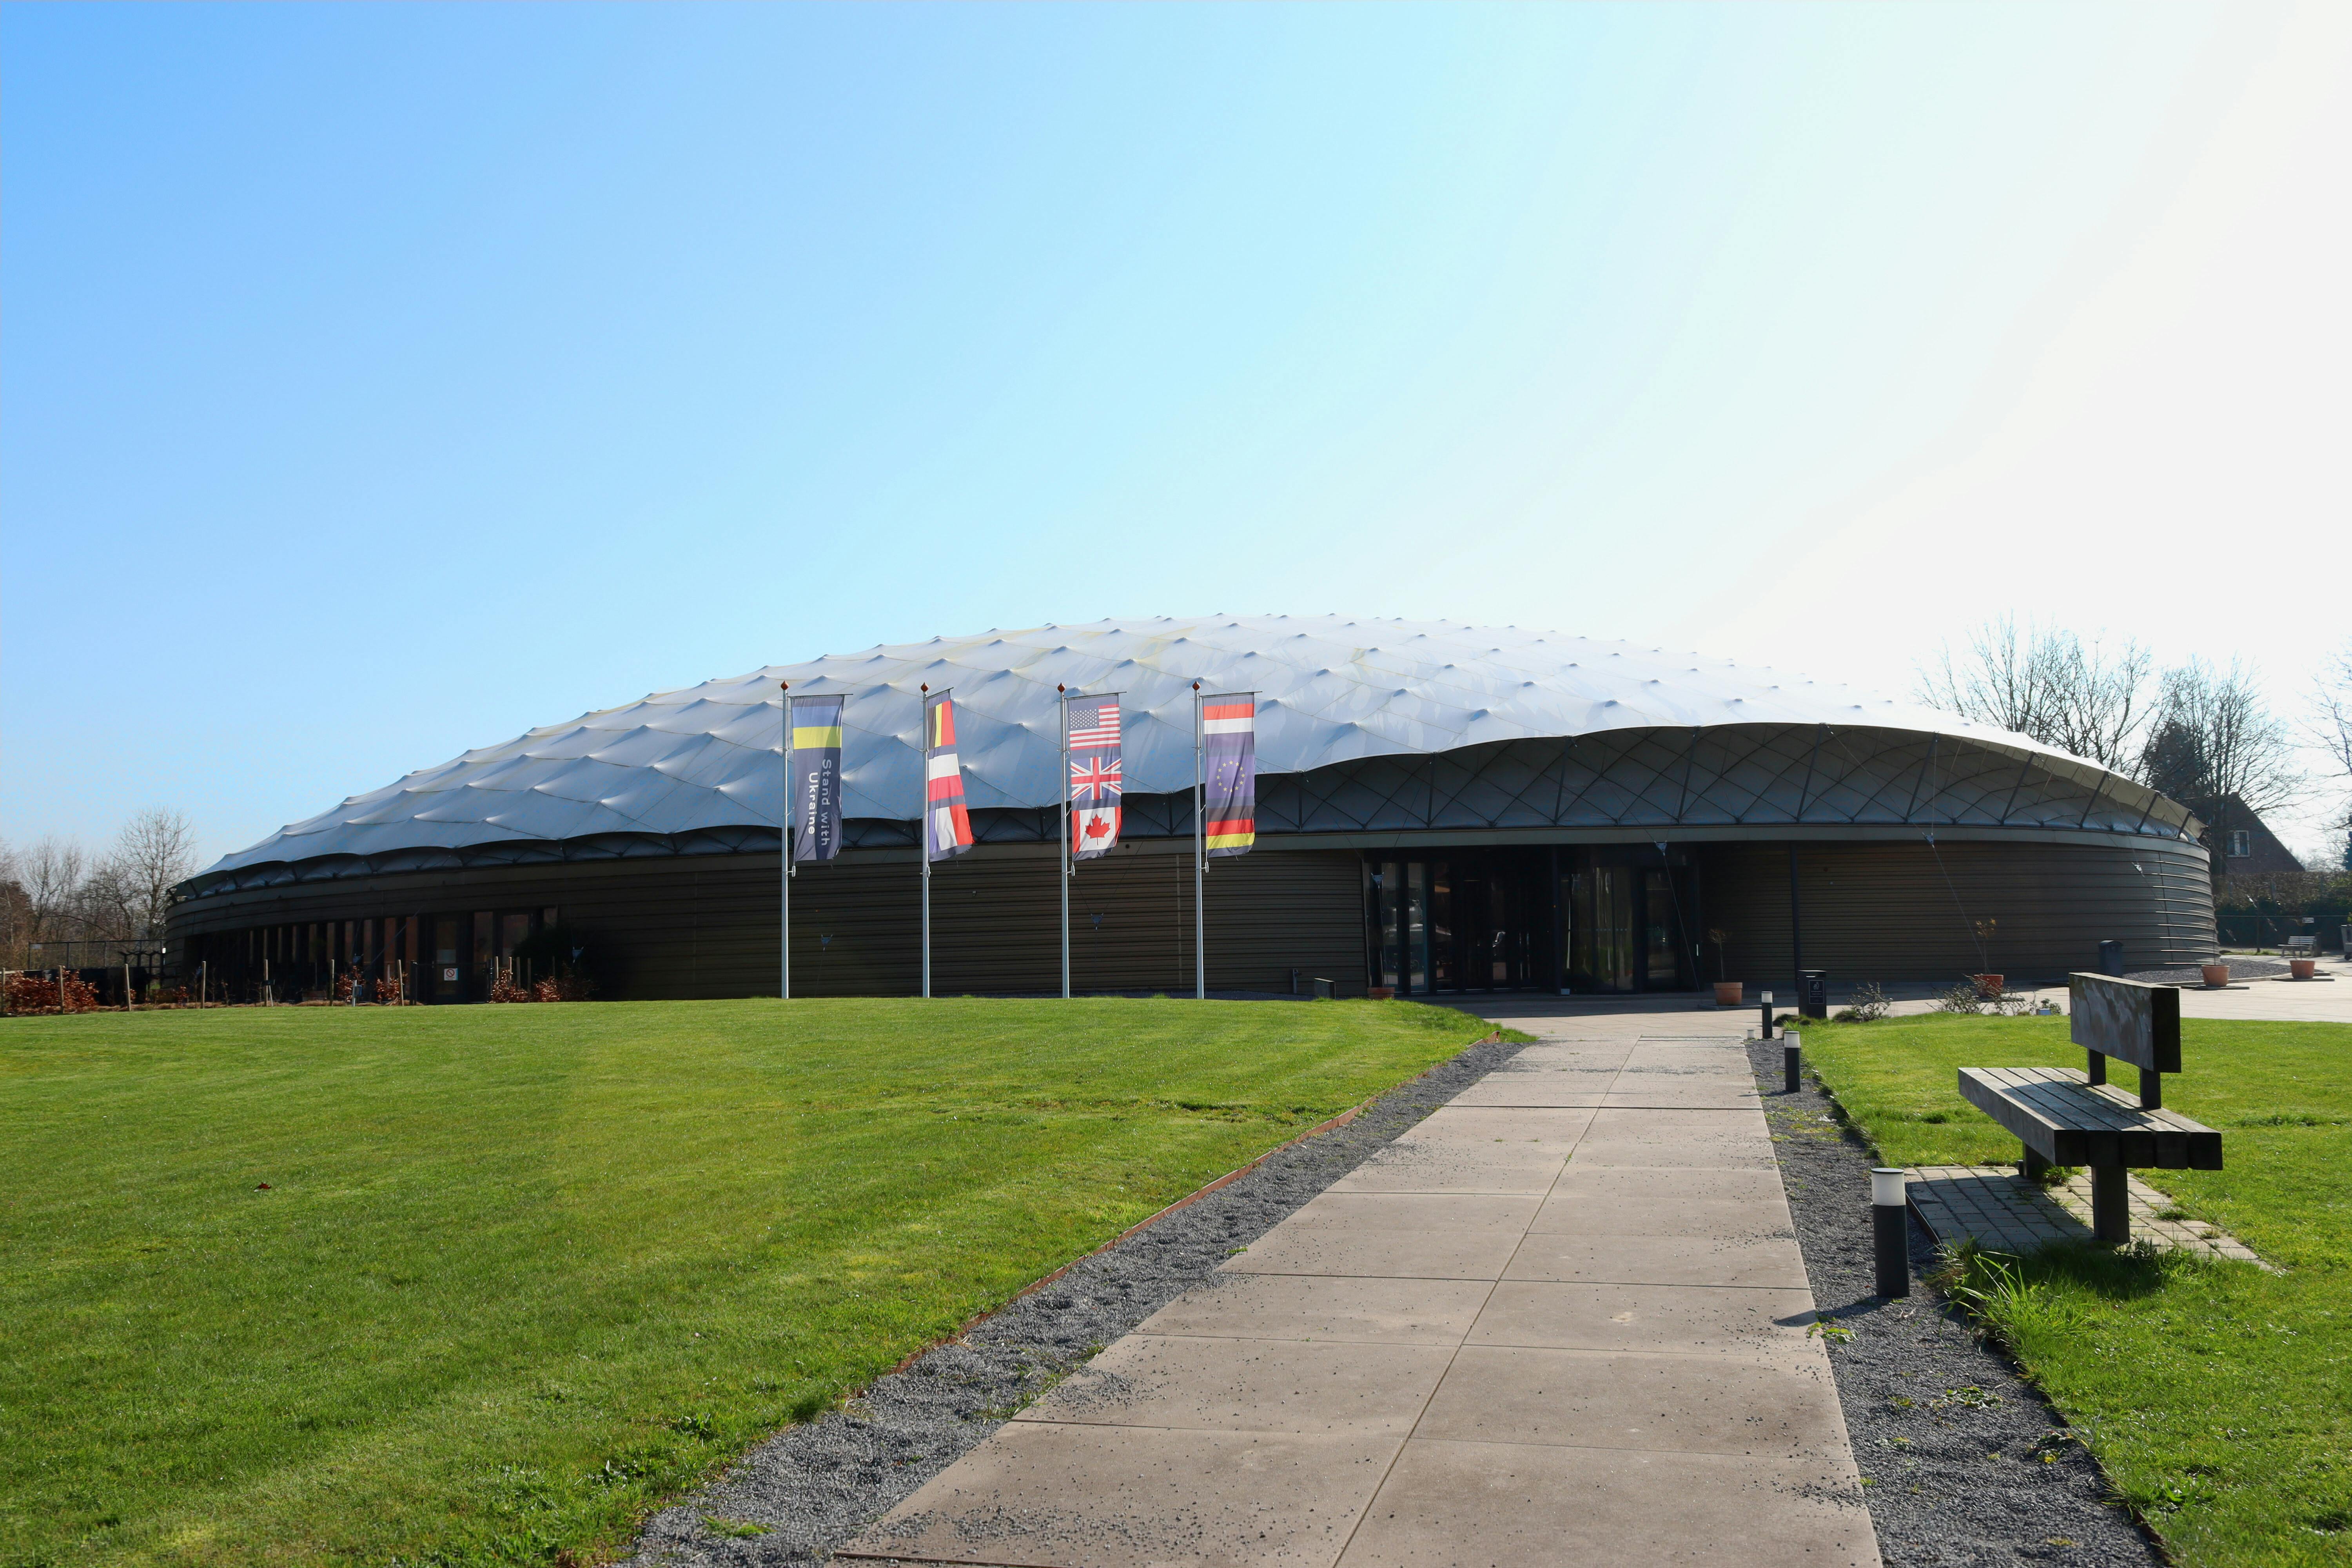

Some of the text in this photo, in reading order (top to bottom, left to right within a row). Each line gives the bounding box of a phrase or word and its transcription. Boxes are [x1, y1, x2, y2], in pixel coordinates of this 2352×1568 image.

[808, 772, 818, 835] Ukraine
[821, 759, 831, 846] Stand with
